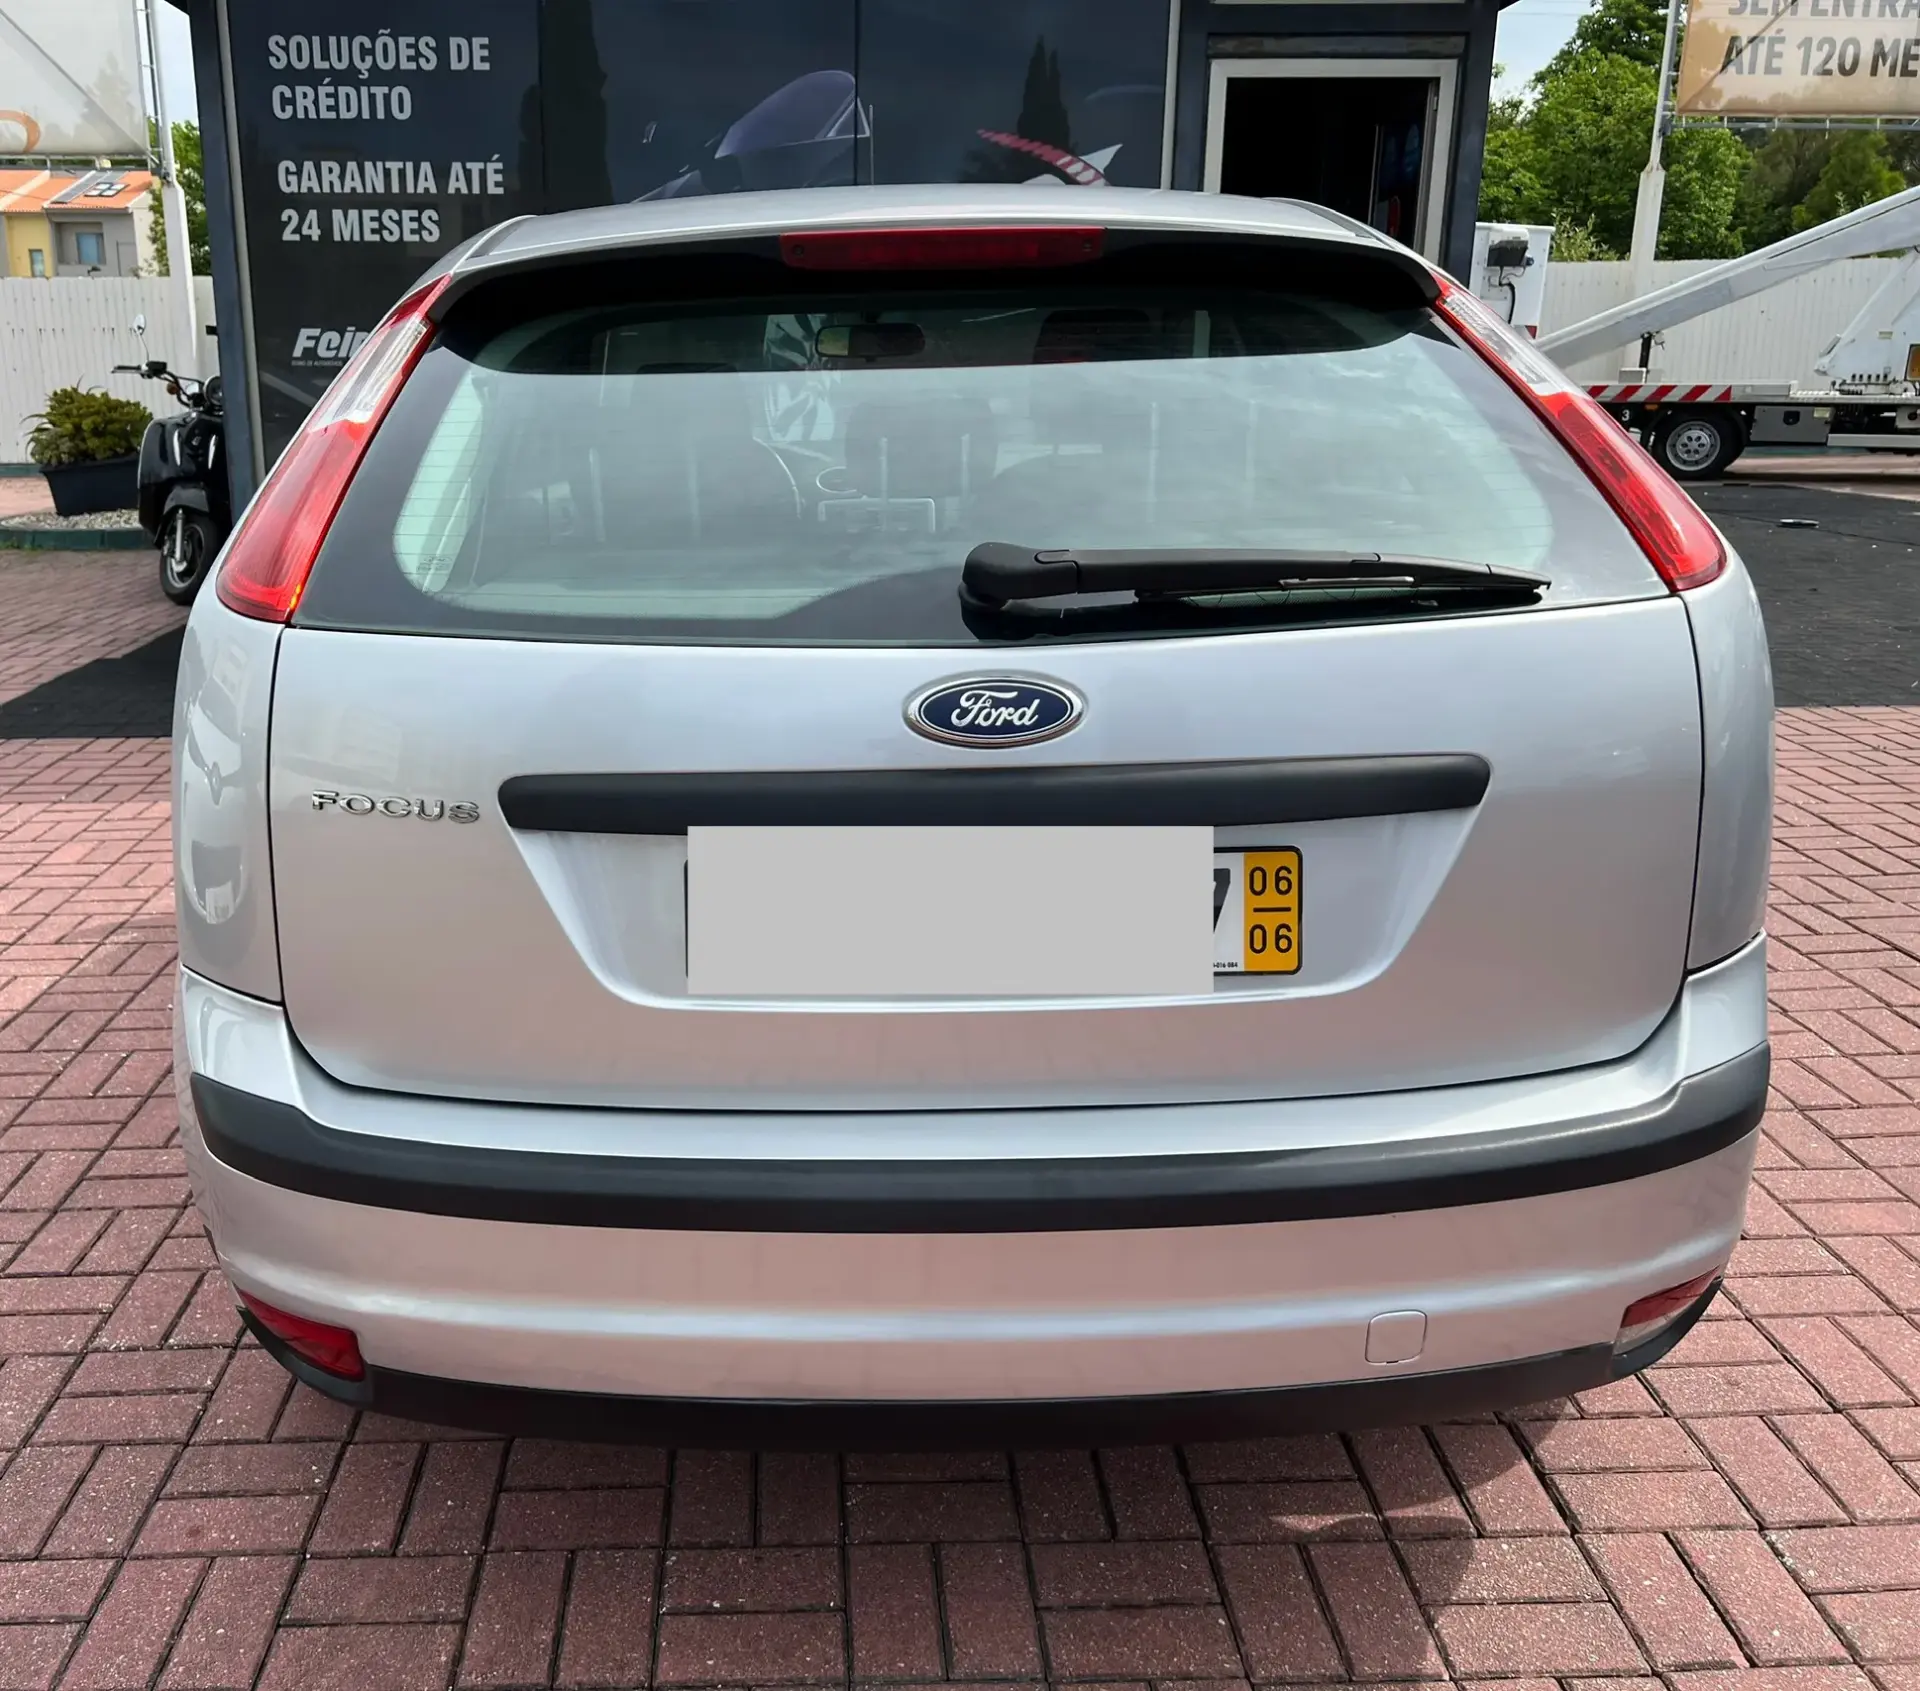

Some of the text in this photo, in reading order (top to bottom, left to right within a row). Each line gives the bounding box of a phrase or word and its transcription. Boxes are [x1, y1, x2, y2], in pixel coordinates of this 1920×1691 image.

[268, 29, 491, 78] SOLUÇÕES DE
[1720, 28, 1786, 76] ATÉ
[1796, 36, 1861, 76] 120
[272, 78, 412, 120] CRÉDITO
[278, 154, 504, 195] GARANTIA ATÉ
[281, 209, 440, 243] 24 MESES
[1621, 409, 1630, 421] 3
[950, 689, 1041, 727] Ford
[312, 789, 480, 824] FOCUS
[1249, 866, 1292, 896] 06
[1249, 923, 1292, 954] 06
